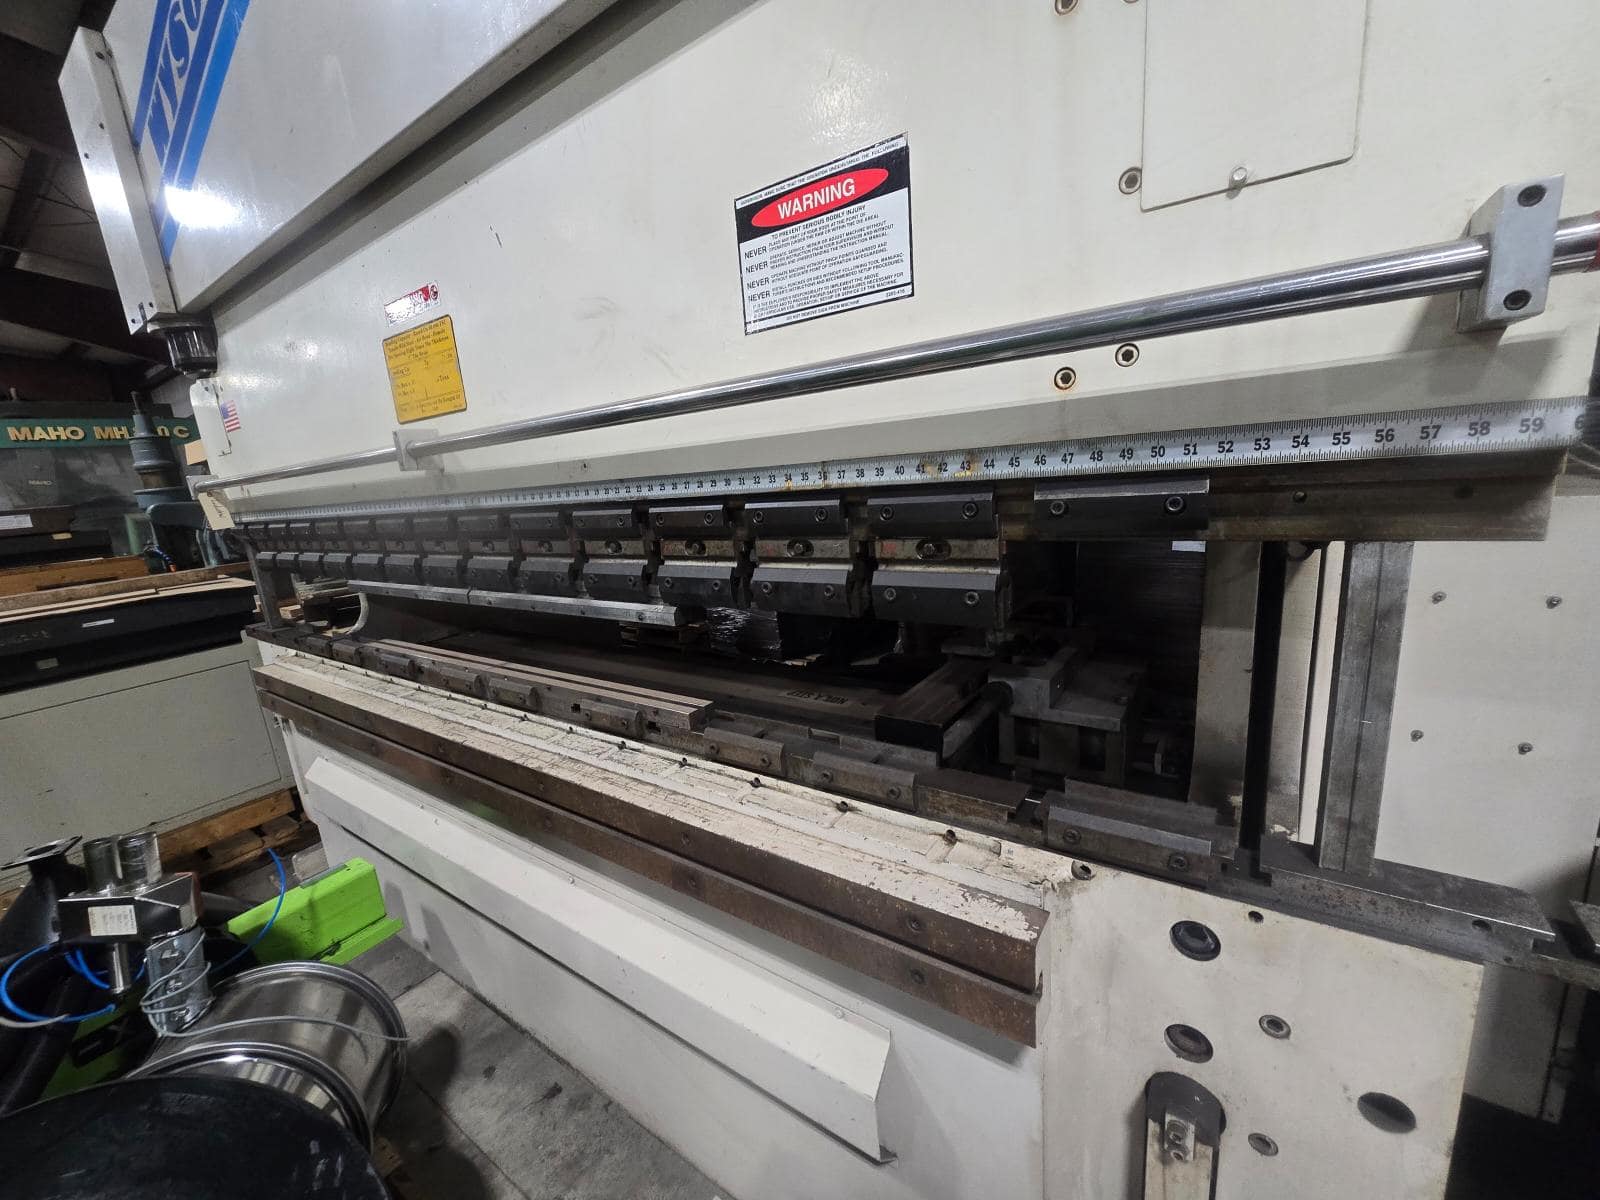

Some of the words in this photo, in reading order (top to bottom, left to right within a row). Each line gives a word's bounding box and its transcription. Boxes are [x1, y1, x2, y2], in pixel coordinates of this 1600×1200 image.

[777, 178, 855, 219] WARNING
[779, 225, 802, 237] PREVENT
[802, 217, 825, 230] SERIOUS
[825, 210, 845, 222] BODILY
[845, 204, 865, 215] INJURY
[744, 245, 766, 259] NEVER
[745, 260, 768, 274] NEVER
[746, 276, 769, 290] NEVER
[748, 289, 770, 303] NEVER
[8, 426, 85, 440] MAHO
[93, 426, 130, 440] MH
[173, 425, 190, 438] C
[753, 476, 760, 484] 32
[769, 474, 776, 483] 33
[801, 472, 808, 481] 35
[818, 472, 827, 480] 36
[838, 470, 845, 479] 37
[856, 469, 864, 478] 38
[875, 467, 884, 477] 39
[895, 466, 904, 475] 40
[916, 464, 925, 474] 41
[938, 463, 948, 472] 42
[960, 461, 970, 470] 43
[984, 459, 994, 469] 44
[1008, 457, 1020, 467] 45
[1034, 454, 1046, 466] 46
[1062, 453, 1074, 464] 47
[1090, 450, 1103, 462] 48
[1120, 448, 1134, 460] 49
[1151, 446, 1165, 458] 50
[1183, 444, 1198, 456] 51
[1218, 440, 1234, 453] 52
[1254, 438, 1270, 451] 53
[1291, 435, 1309, 448] 54
[1332, 432, 1351, 446] 55
[1375, 428, 1395, 442] 56
[1420, 424, 1442, 439] 57
[1468, 421, 1490, 437] 58
[1518, 417, 1544, 433] 59
[1575, 414, 1584, 429] 6
